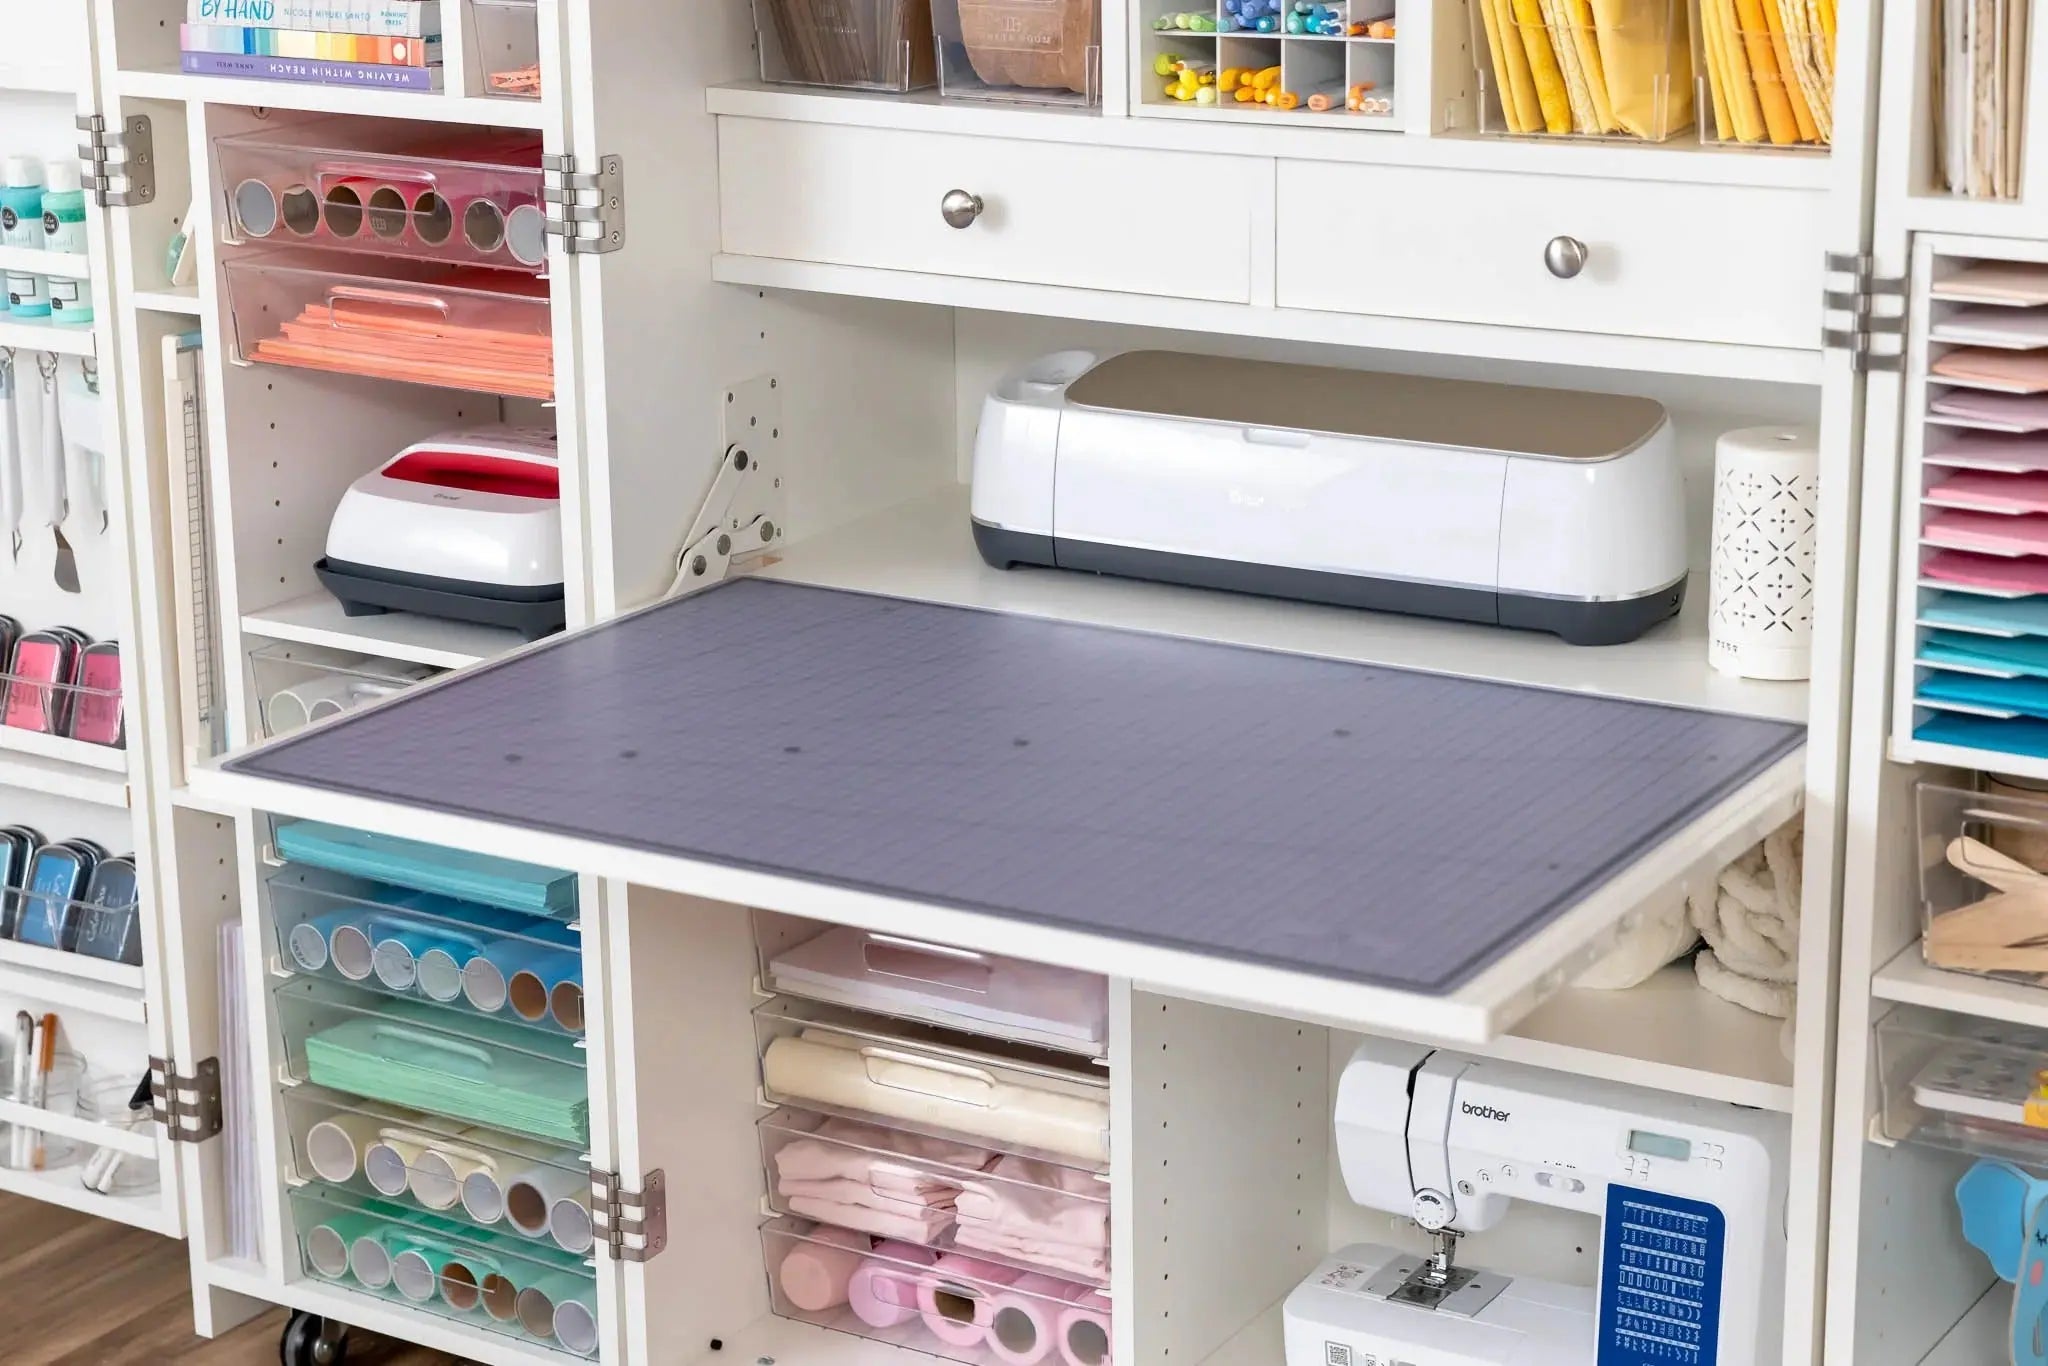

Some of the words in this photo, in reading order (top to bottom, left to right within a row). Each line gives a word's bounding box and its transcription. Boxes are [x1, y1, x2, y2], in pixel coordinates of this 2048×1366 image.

[201, 0, 222, 18] BY
[224, 0, 275, 21] HAND
[284, 8, 312, 17] NICOLE
[344, 12, 371, 21] SANTO
[270, 63, 306, 75] REACH
[312, 67, 352, 79] WITHIN
[357, 70, 410, 83] WEAVING
[1461, 1100, 1511, 1122] brother
